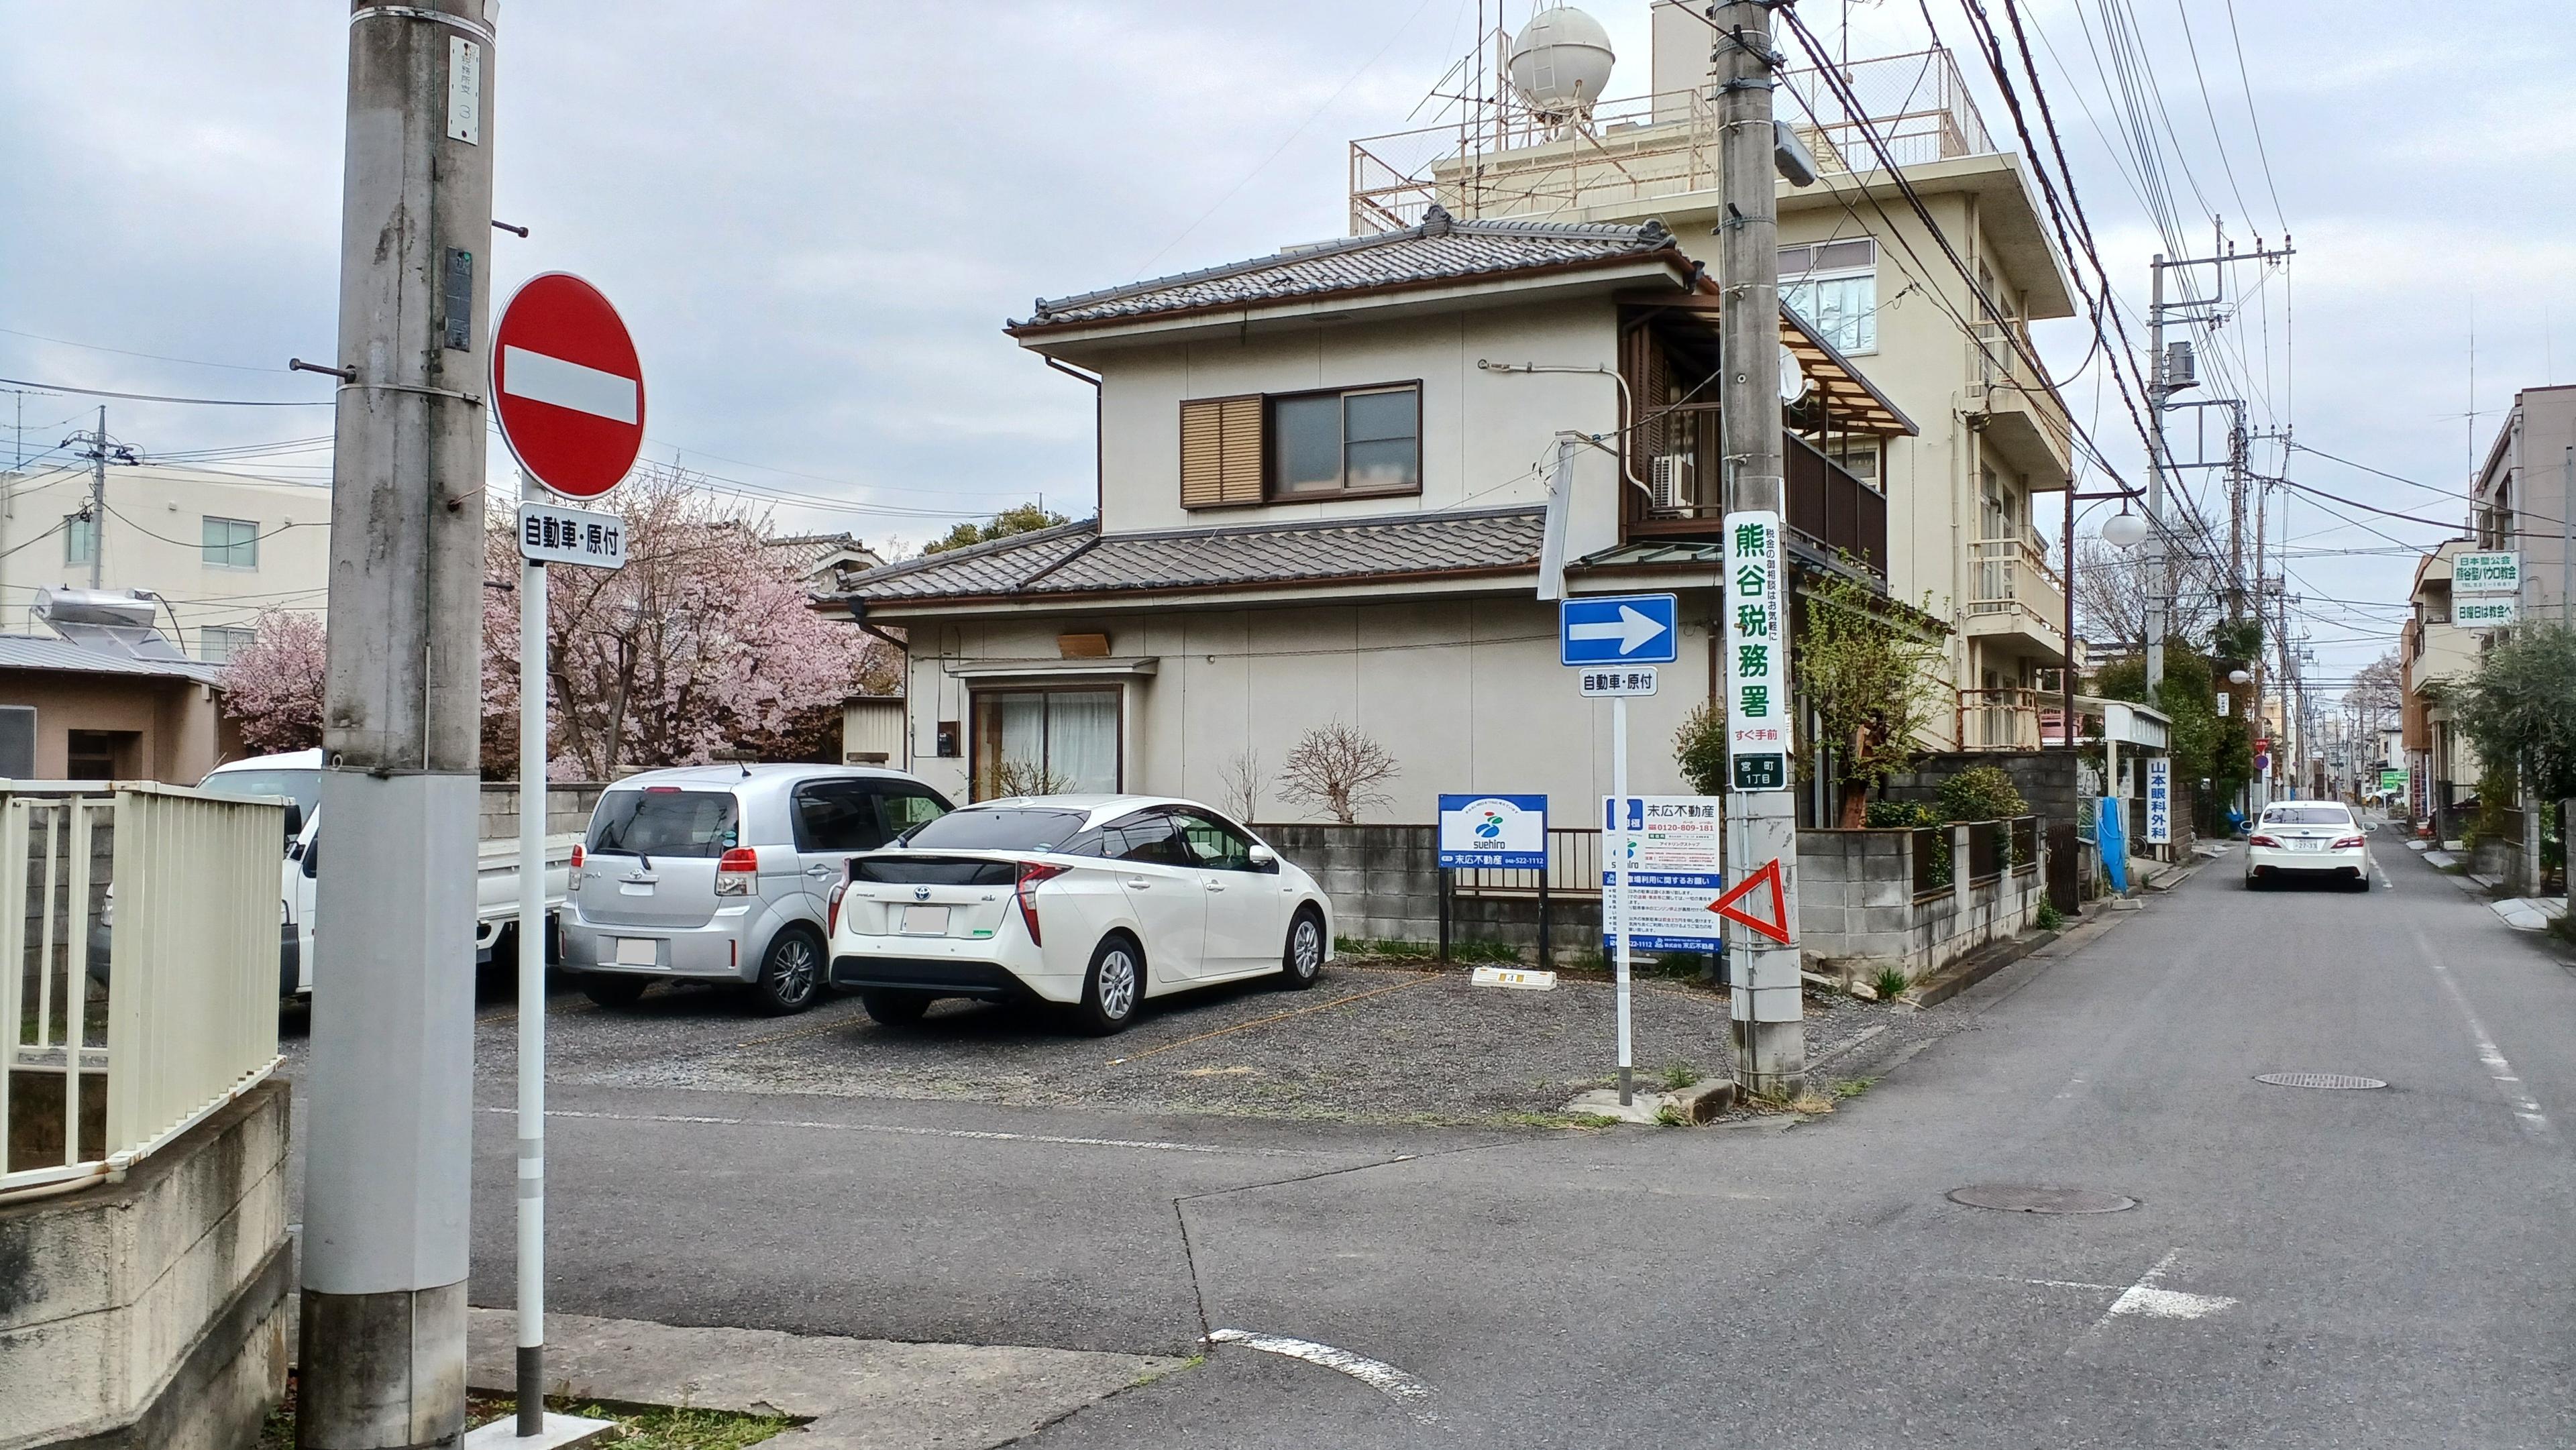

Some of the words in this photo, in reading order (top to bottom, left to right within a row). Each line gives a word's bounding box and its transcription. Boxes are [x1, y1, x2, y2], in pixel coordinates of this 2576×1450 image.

[526, 514, 619, 556] 自動車・原付
[2456, 566, 2516, 581] 熊谷聖パウロ教会
[1766, 528, 1778, 641] 税金の御相談はお気軽に
[2459, 605, 2512, 619] 日曜日は教会へ
[1735, 523, 1769, 718] 熊谷税務署
[1584, 673, 1652, 690] 自動車・原付
[1735, 729, 1777, 740] すぐ手前
[1746, 774, 1770, 784] 1丁目
[2151, 761, 2166, 839] 山本眼科外科
[1648, 804, 1714, 818] 末広不動産
[1473, 840, 1505, 849] suehiro
[1454, 854, 1503, 865] 末広不動産
[1628, 876, 1710, 885] 車場利用に関するお願い
